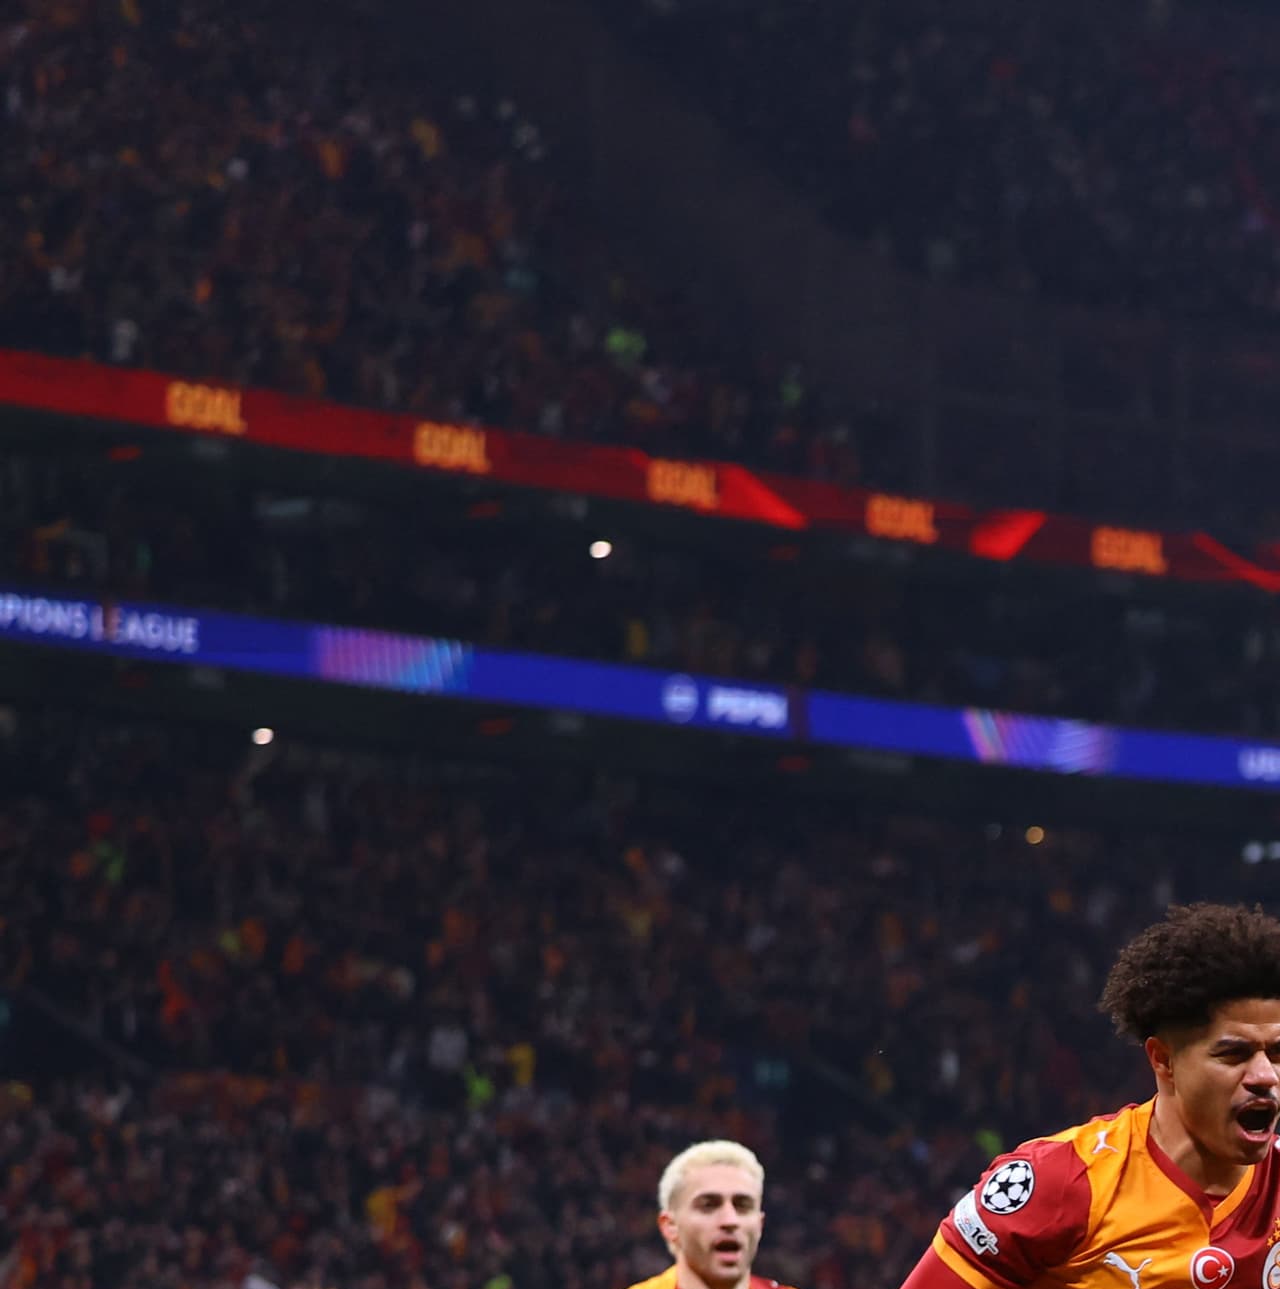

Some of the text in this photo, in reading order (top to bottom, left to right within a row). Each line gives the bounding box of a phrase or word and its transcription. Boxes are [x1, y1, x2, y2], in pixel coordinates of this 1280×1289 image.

[167, 381, 246, 434] GOAL
[414, 421, 490, 474] GOAL
[91, 606, 200, 654] LEAGUE
